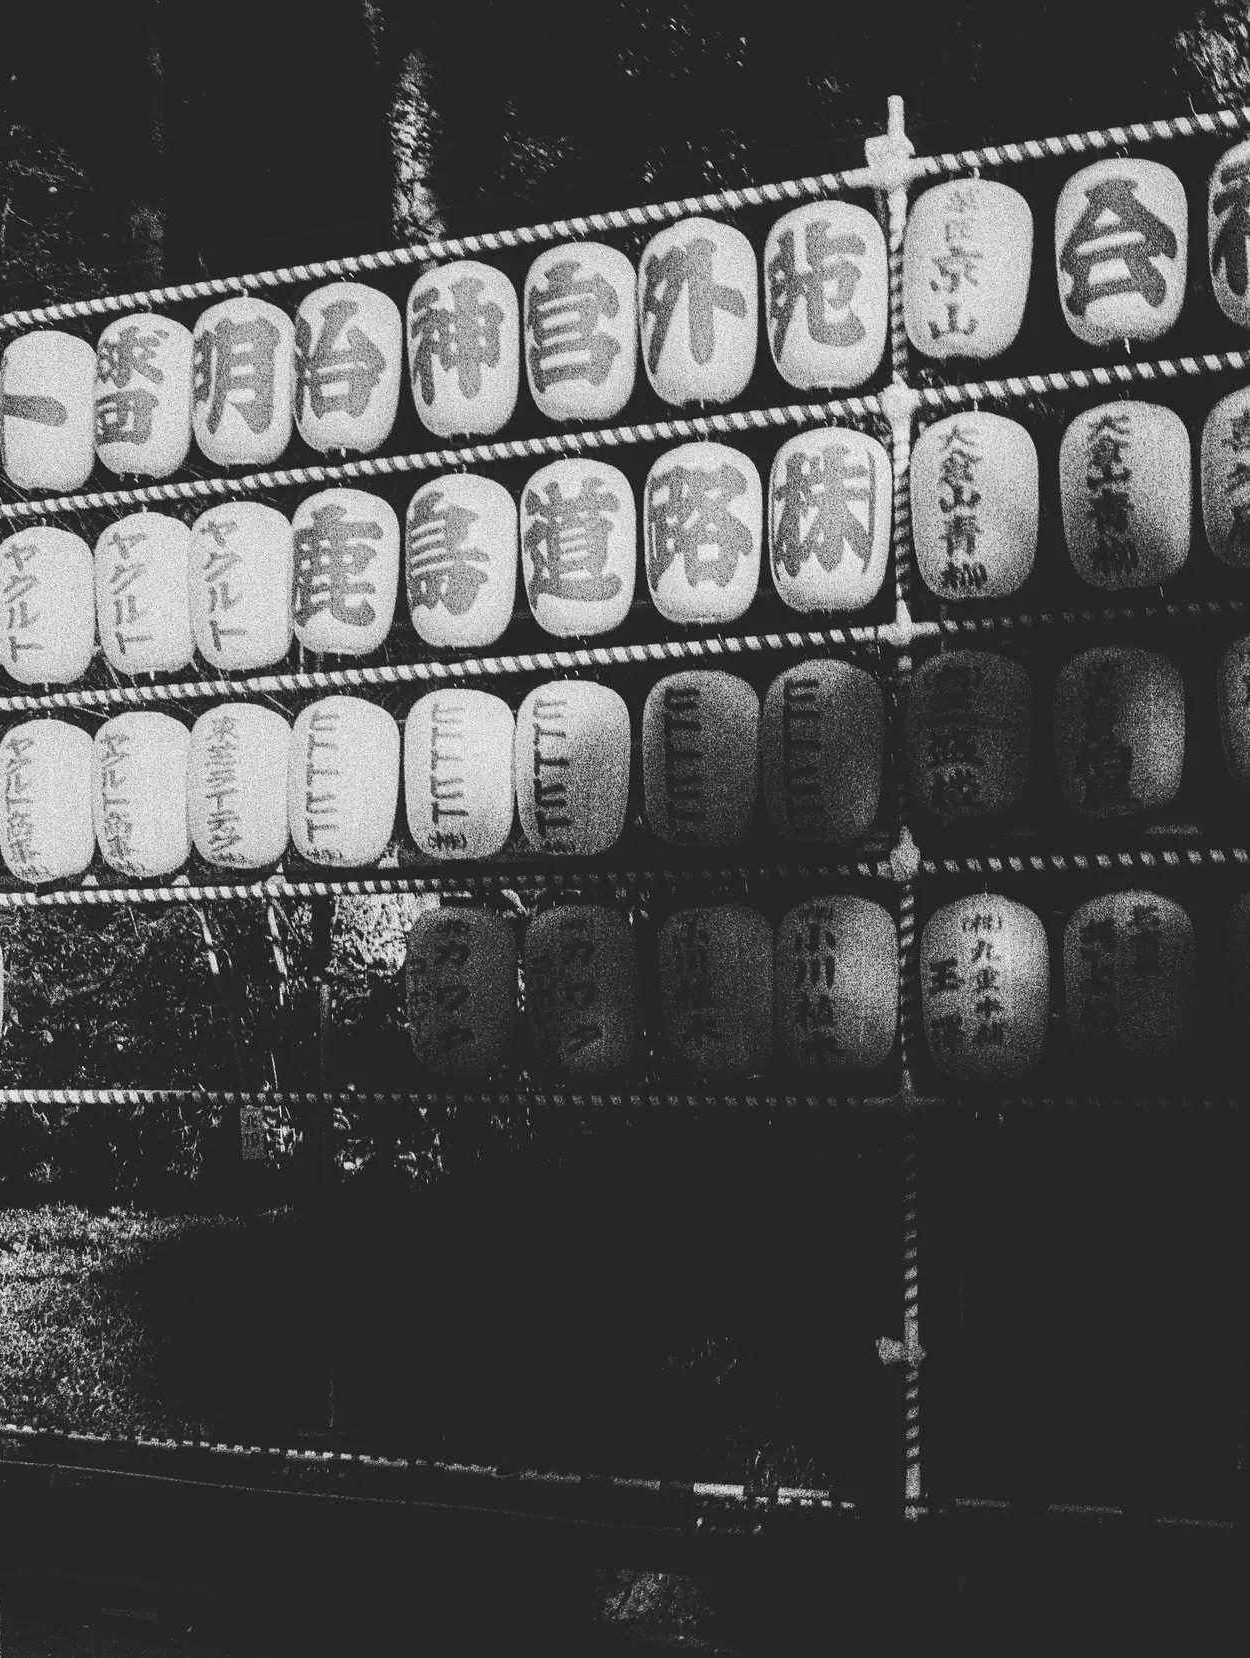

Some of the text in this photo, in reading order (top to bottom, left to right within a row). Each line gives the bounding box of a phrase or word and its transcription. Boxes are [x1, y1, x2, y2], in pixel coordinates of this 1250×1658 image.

[3, 543, 42, 662] ヤクルト
[113, 533, 152, 654] ヤクルト
[204, 520, 245, 651] ヤクルト
